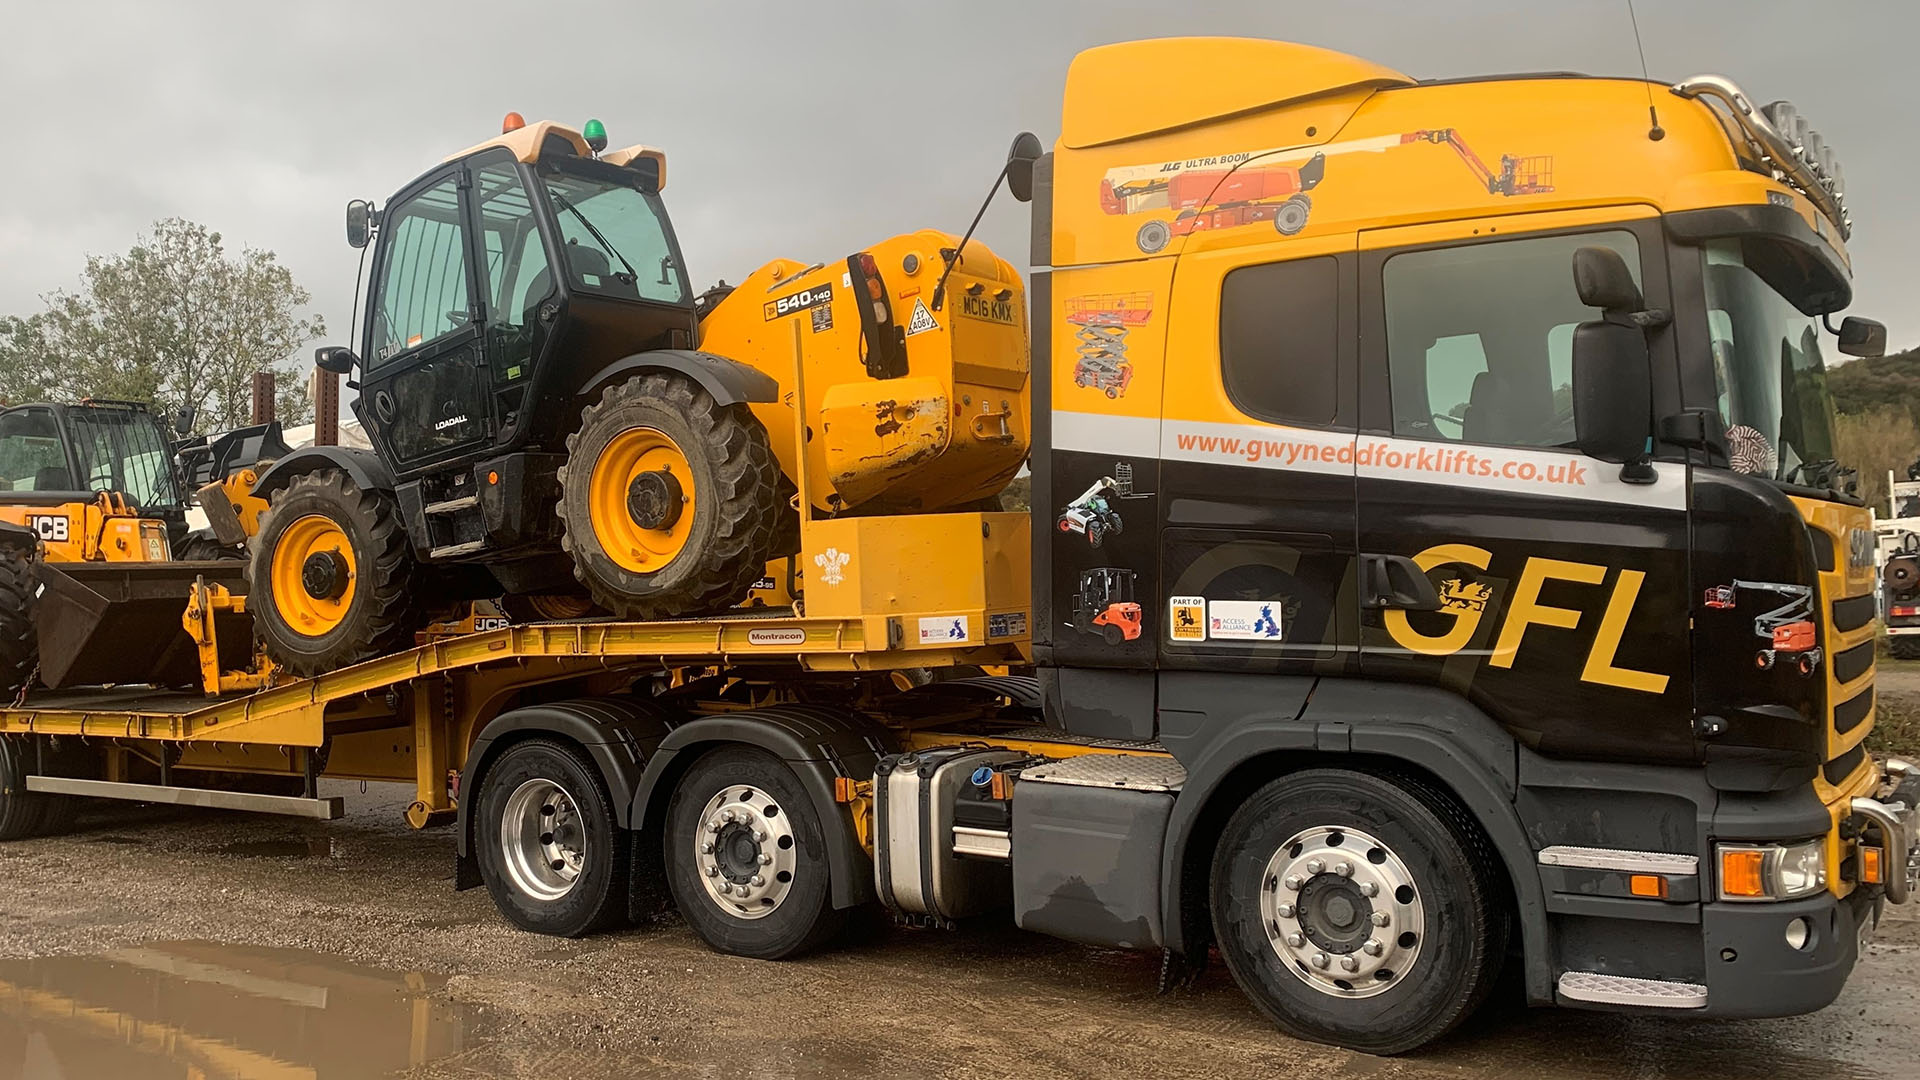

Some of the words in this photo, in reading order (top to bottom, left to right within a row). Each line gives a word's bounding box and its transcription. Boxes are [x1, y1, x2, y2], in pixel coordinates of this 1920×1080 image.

[1160, 162, 1181, 173] JLG
[1185, 157, 1217, 169] ULTRA
[1220, 152, 1250, 163] BOOM
[777, 290, 831, 313] 540-140
[963, 296, 989, 318] MC16
[991, 300, 1013, 322] KMX
[916, 310, 925, 320] 17
[435, 414, 468, 431] LOADALL
[1177, 431, 1587, 486] www.gwyneddforklifts.co.uk
[31, 516, 69, 541] JCB
[1384, 543, 1670, 694] GFL
